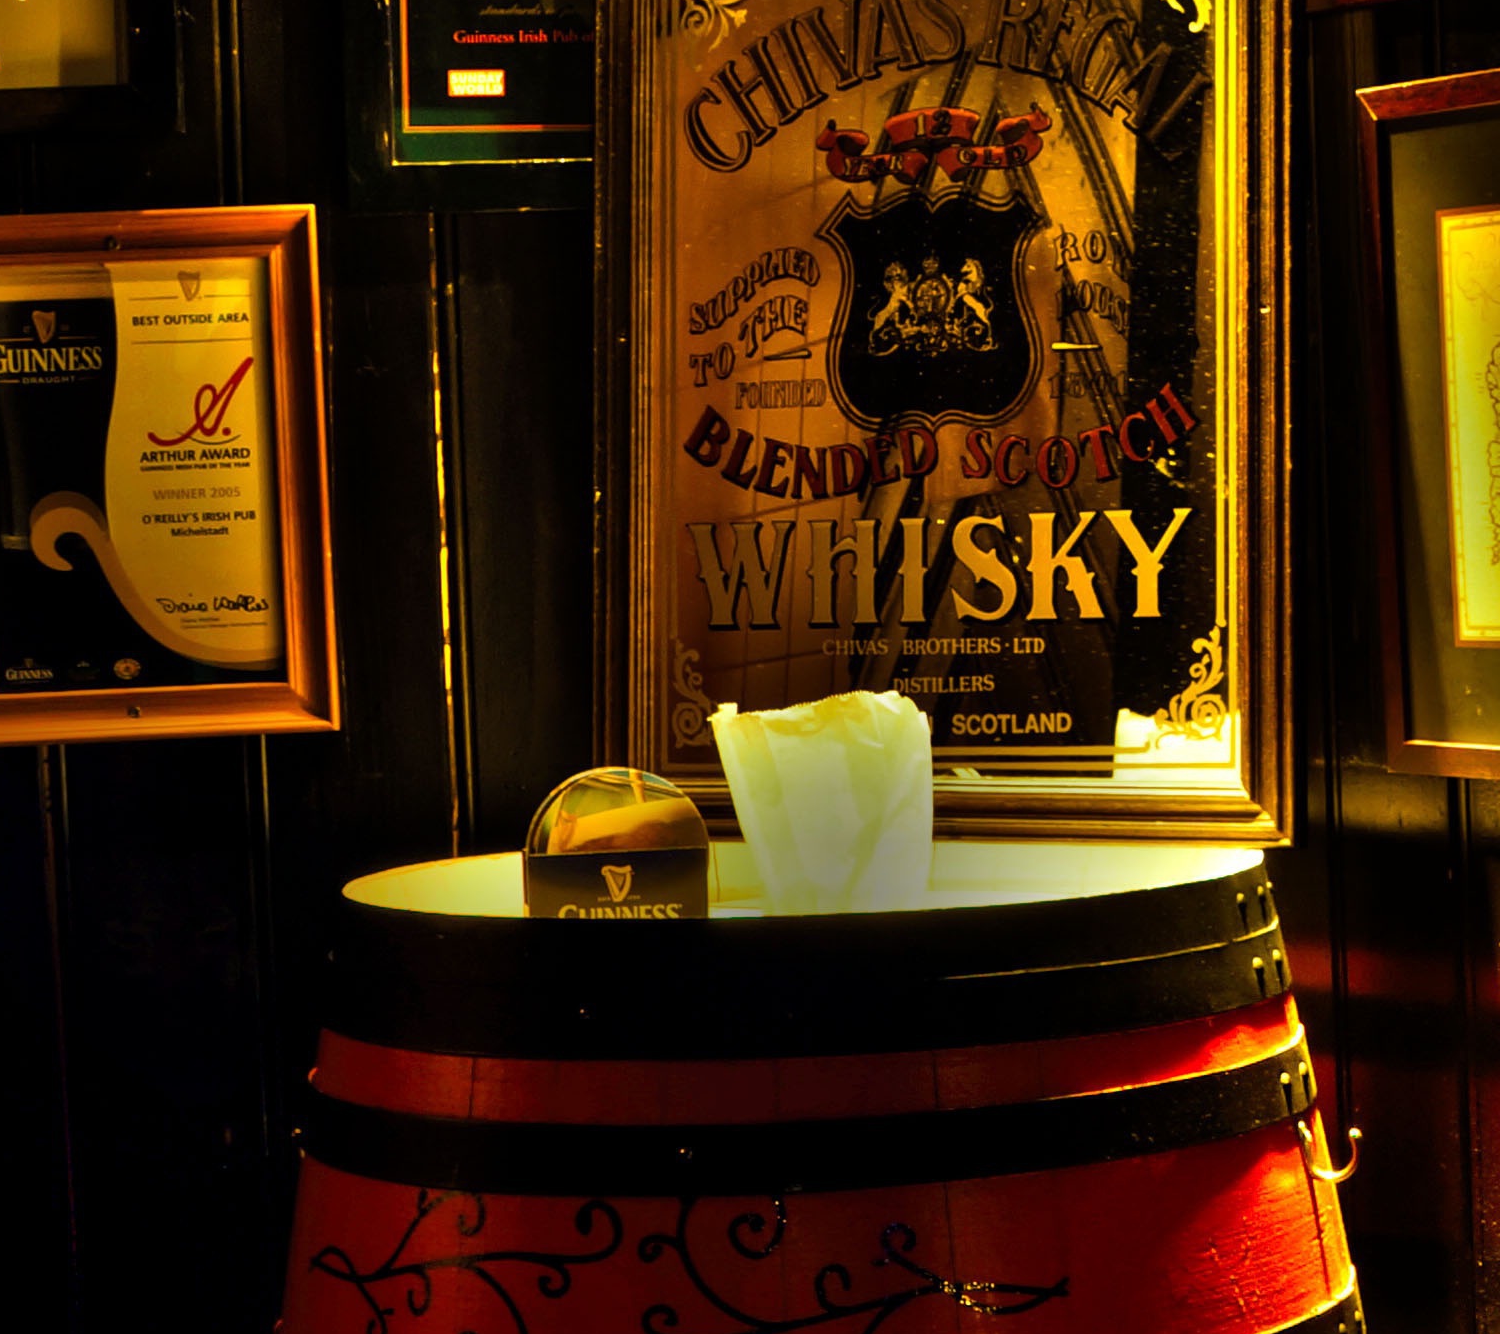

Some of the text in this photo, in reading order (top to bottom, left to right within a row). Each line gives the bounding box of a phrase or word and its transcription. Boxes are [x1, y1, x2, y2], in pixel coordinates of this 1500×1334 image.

[452, 28, 516, 44] Guinness
[518, 28, 549, 44] Irish
[914, 111, 952, 137] 12
[956, 144, 1031, 169] OLD
[687, 245, 822, 336] SUPPLIED
[131, 312, 250, 327] BEST OUTSIDE AREA
[689, 293, 810, 389] TO THE
[733, 378, 828, 410] FOUNDED
[684, 382, 1200, 500] BLENDED SCOTCH
[139, 447, 251, 463] ARTHUR AWARD
[152, 485, 242, 501] WINNER 2005
[201, 511, 232, 523] IRISH
[233, 509, 257, 521] PUB
[686, 507, 1194, 631] WHISKY
[821, 635, 1047, 658] CHIVAS BROTHERS LTD
[892, 673, 997, 695] DISTILLERS
[950, 710, 1074, 737] SCOTLAND
